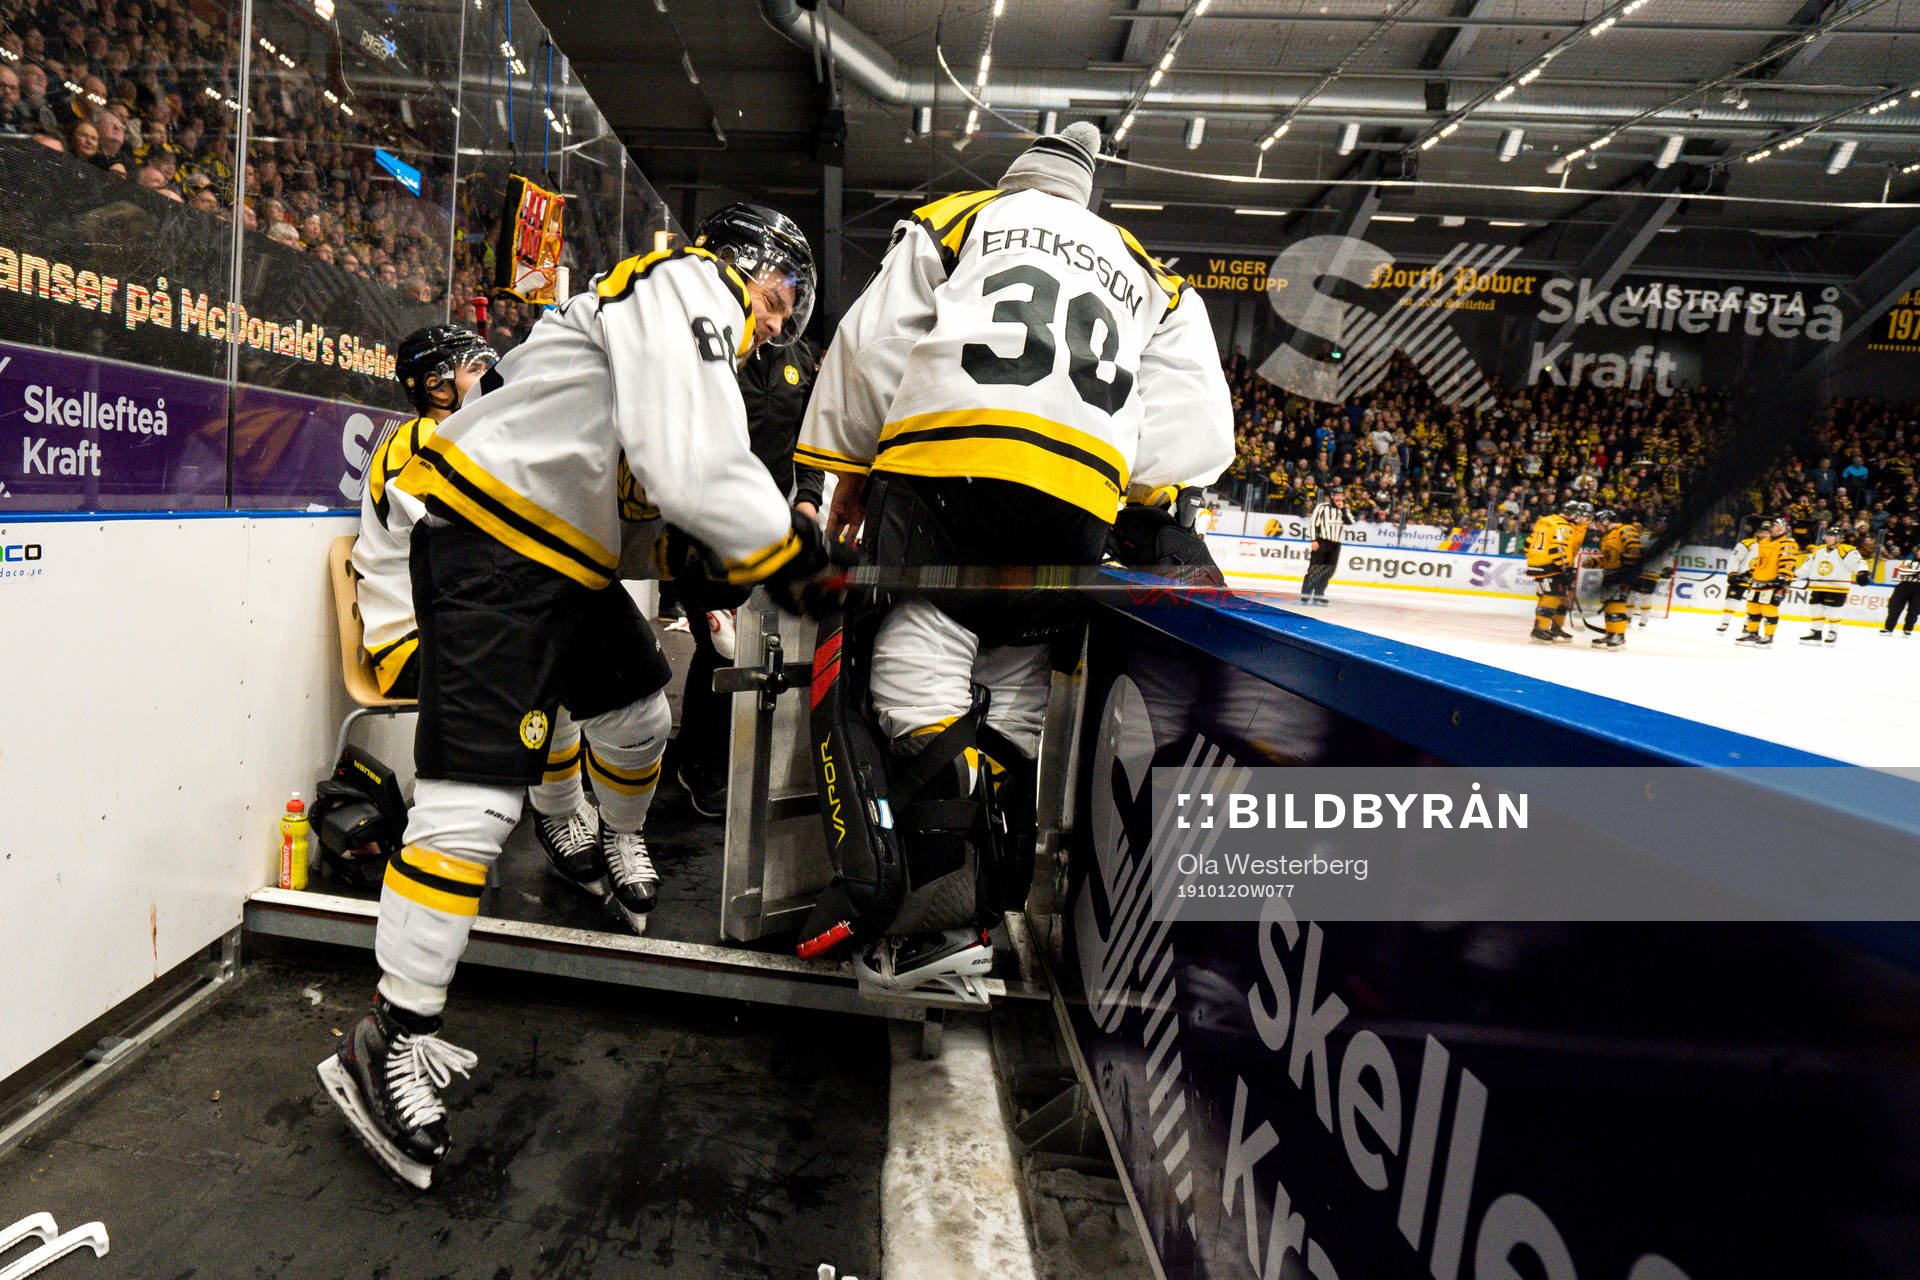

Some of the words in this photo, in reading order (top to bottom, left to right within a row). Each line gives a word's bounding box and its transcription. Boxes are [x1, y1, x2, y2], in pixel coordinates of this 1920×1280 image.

[982, 227, 1143, 319] ERIKSSON
[1186, 275, 1249, 290] ALDRIG
[1253, 278, 1288, 292] UPP
[1209, 259, 1226, 273] VI
[1229, 261, 1266, 275] GER
[1365, 262, 1444, 293] North
[1453, 266, 1537, 296] Power
[1537, 278, 1844, 343] Skellefteå
[1624, 283, 1742, 314] VÄSTRA
[1747, 292, 1806, 317] STÅ
[126, 277, 172, 330] på
[180, 287, 335, 366] McDonald's
[338, 333, 400, 382] Skelle
[961, 264, 1133, 417] 30
[1527, 341, 1678, 398] Kraft
[23, 385, 168, 436] Skellefteå
[23, 436, 102, 476] Kraft
[0, 544, 42, 562] co
[1259, 545, 1311, 561] valut
[1348, 556, 1453, 579] engcon
[820, 731, 846, 849] VAPOR
[1248, 893, 1692, 1280] Skelle
